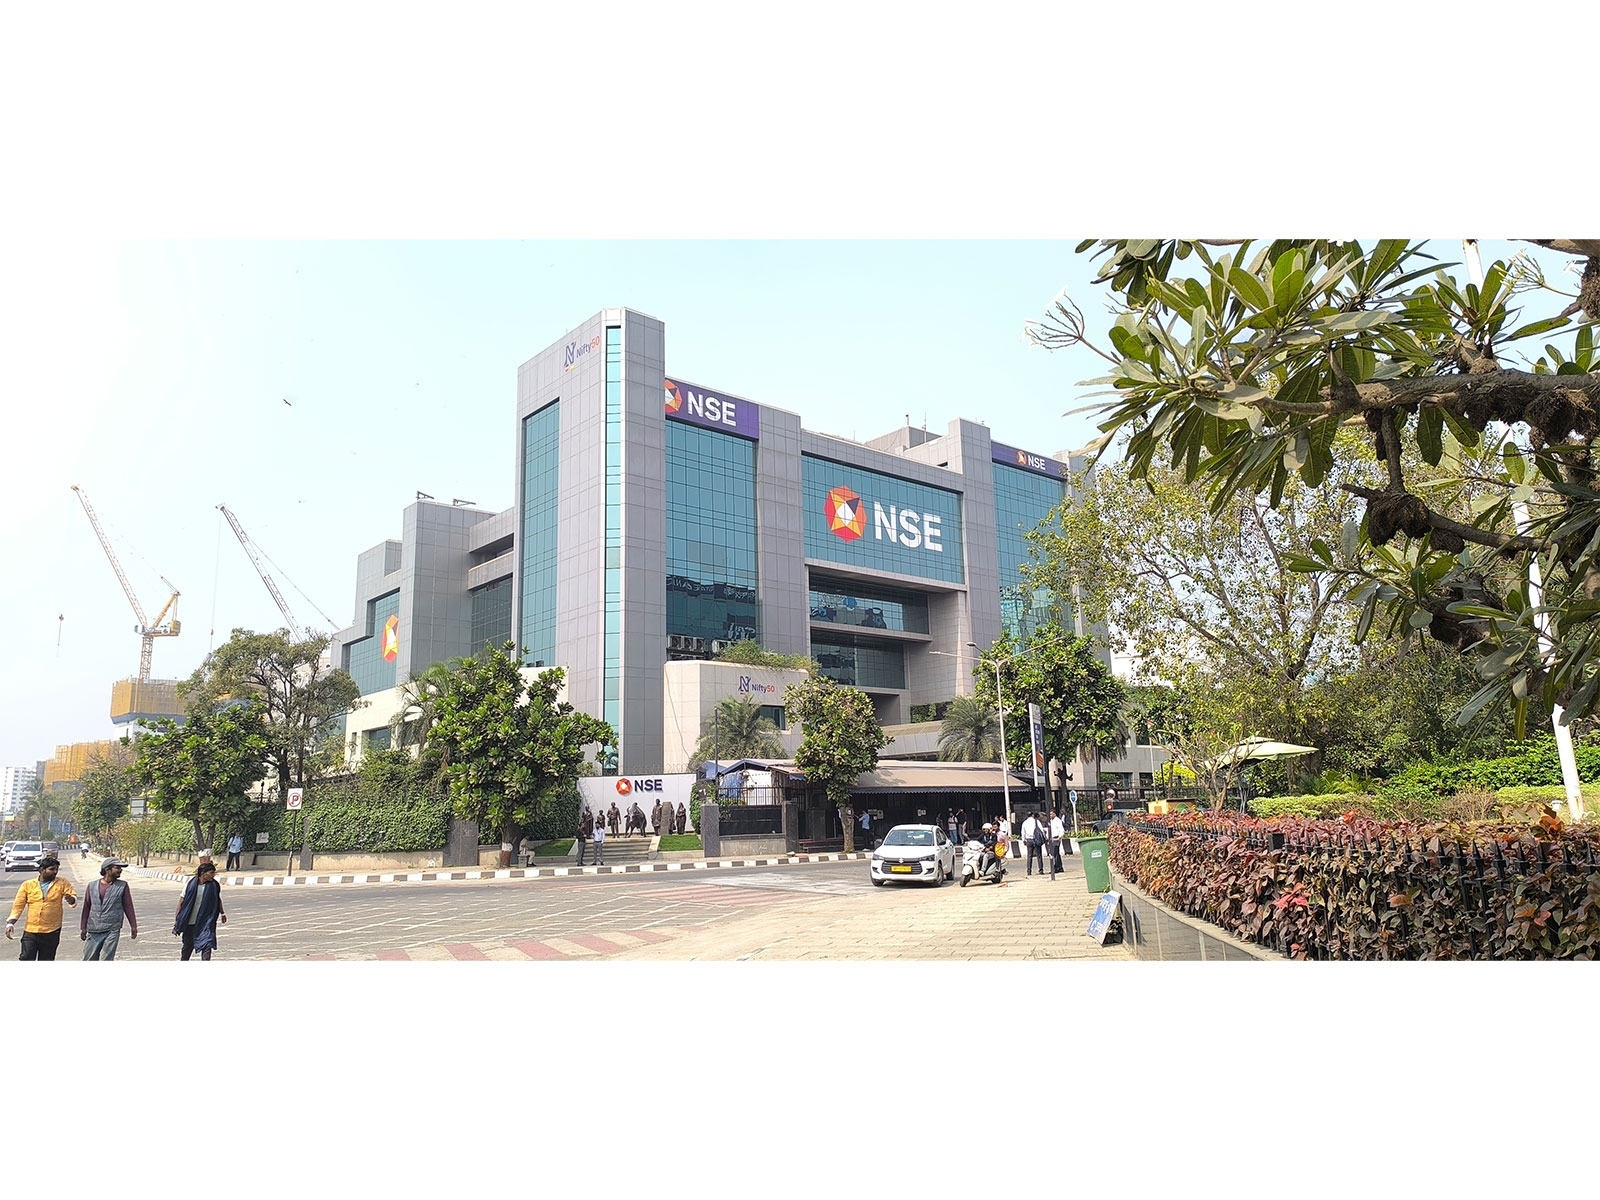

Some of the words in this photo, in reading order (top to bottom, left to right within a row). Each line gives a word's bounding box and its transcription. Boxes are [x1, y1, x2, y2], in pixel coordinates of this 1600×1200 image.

[577, 336, 600, 358] Nifty50
[687, 391, 736, 427] NSE
[1027, 455, 1046, 471] NSE
[874, 501, 943, 552] NSE
[752, 684, 775, 694] Nifty50
[635, 779, 663, 792] NSE
